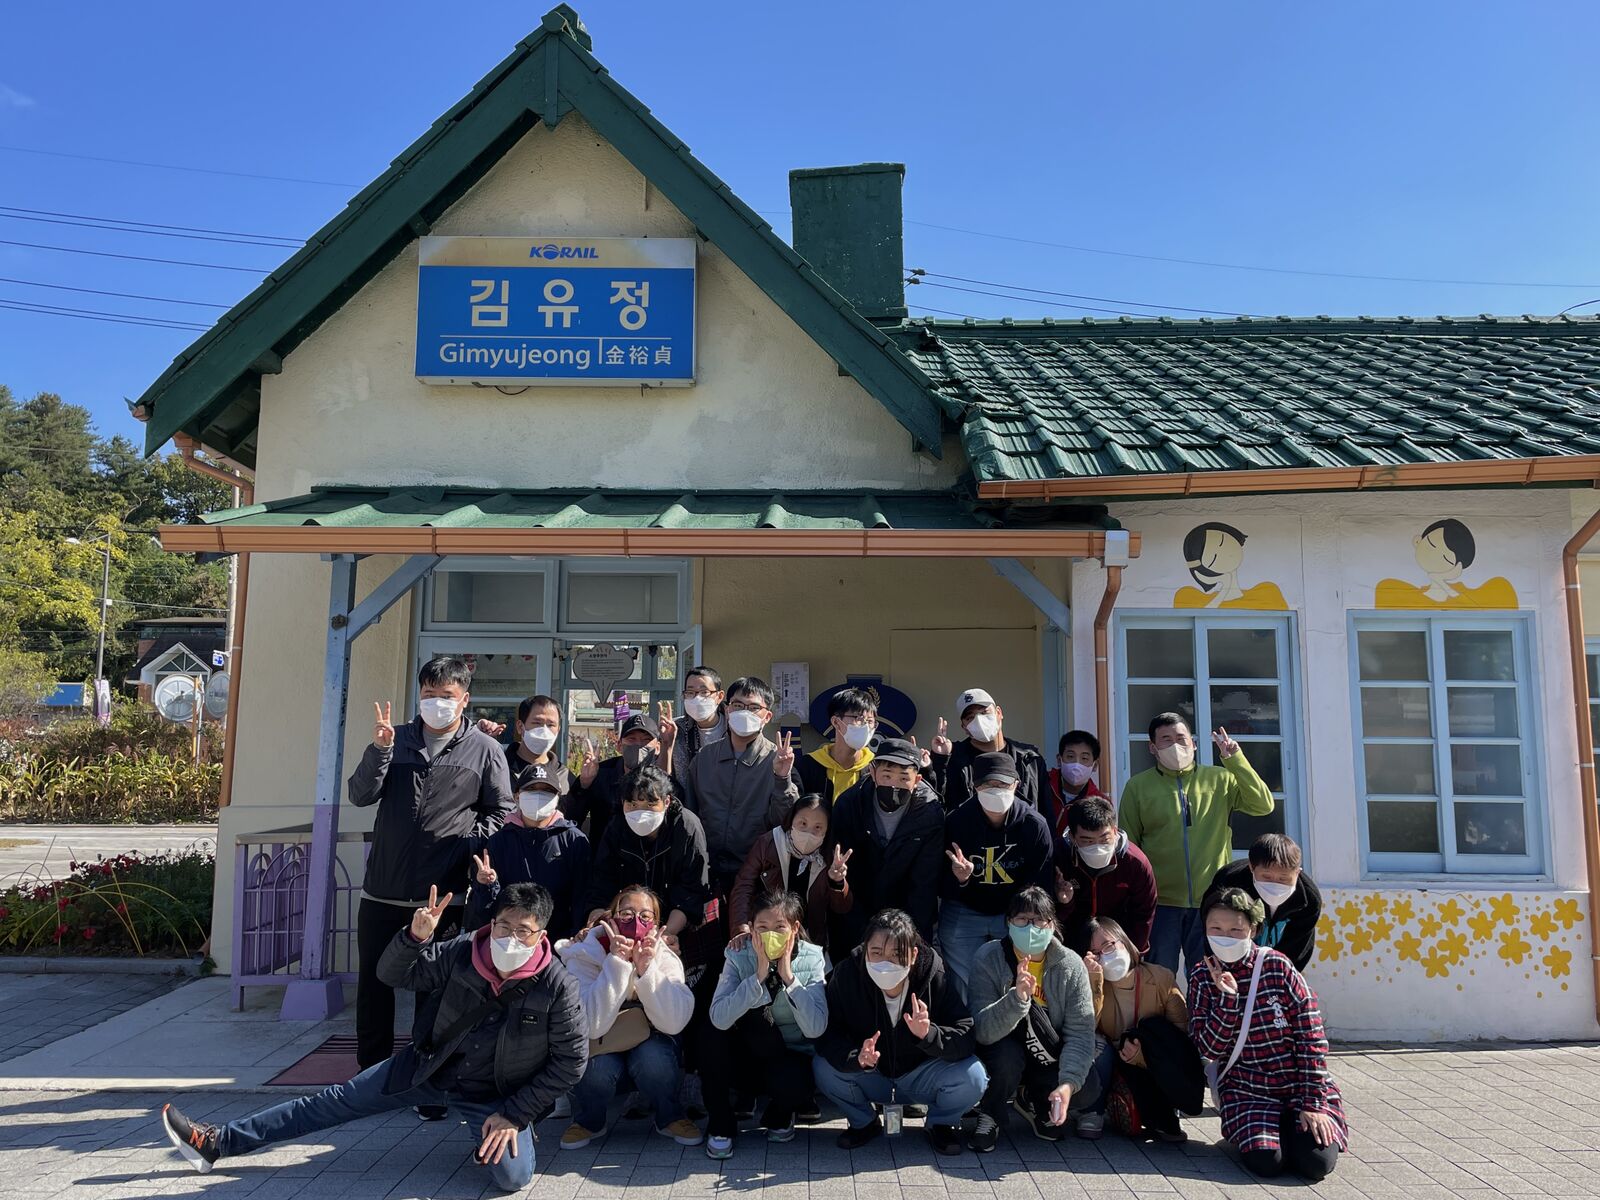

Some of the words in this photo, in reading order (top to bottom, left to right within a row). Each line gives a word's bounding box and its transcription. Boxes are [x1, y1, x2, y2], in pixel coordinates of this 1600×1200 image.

[529, 244, 599, 260] KORAIL
[439, 342, 591, 370] Gimyujeong
[605, 344, 672, 366] 金裕貞
[535, 766, 547, 779] LA
